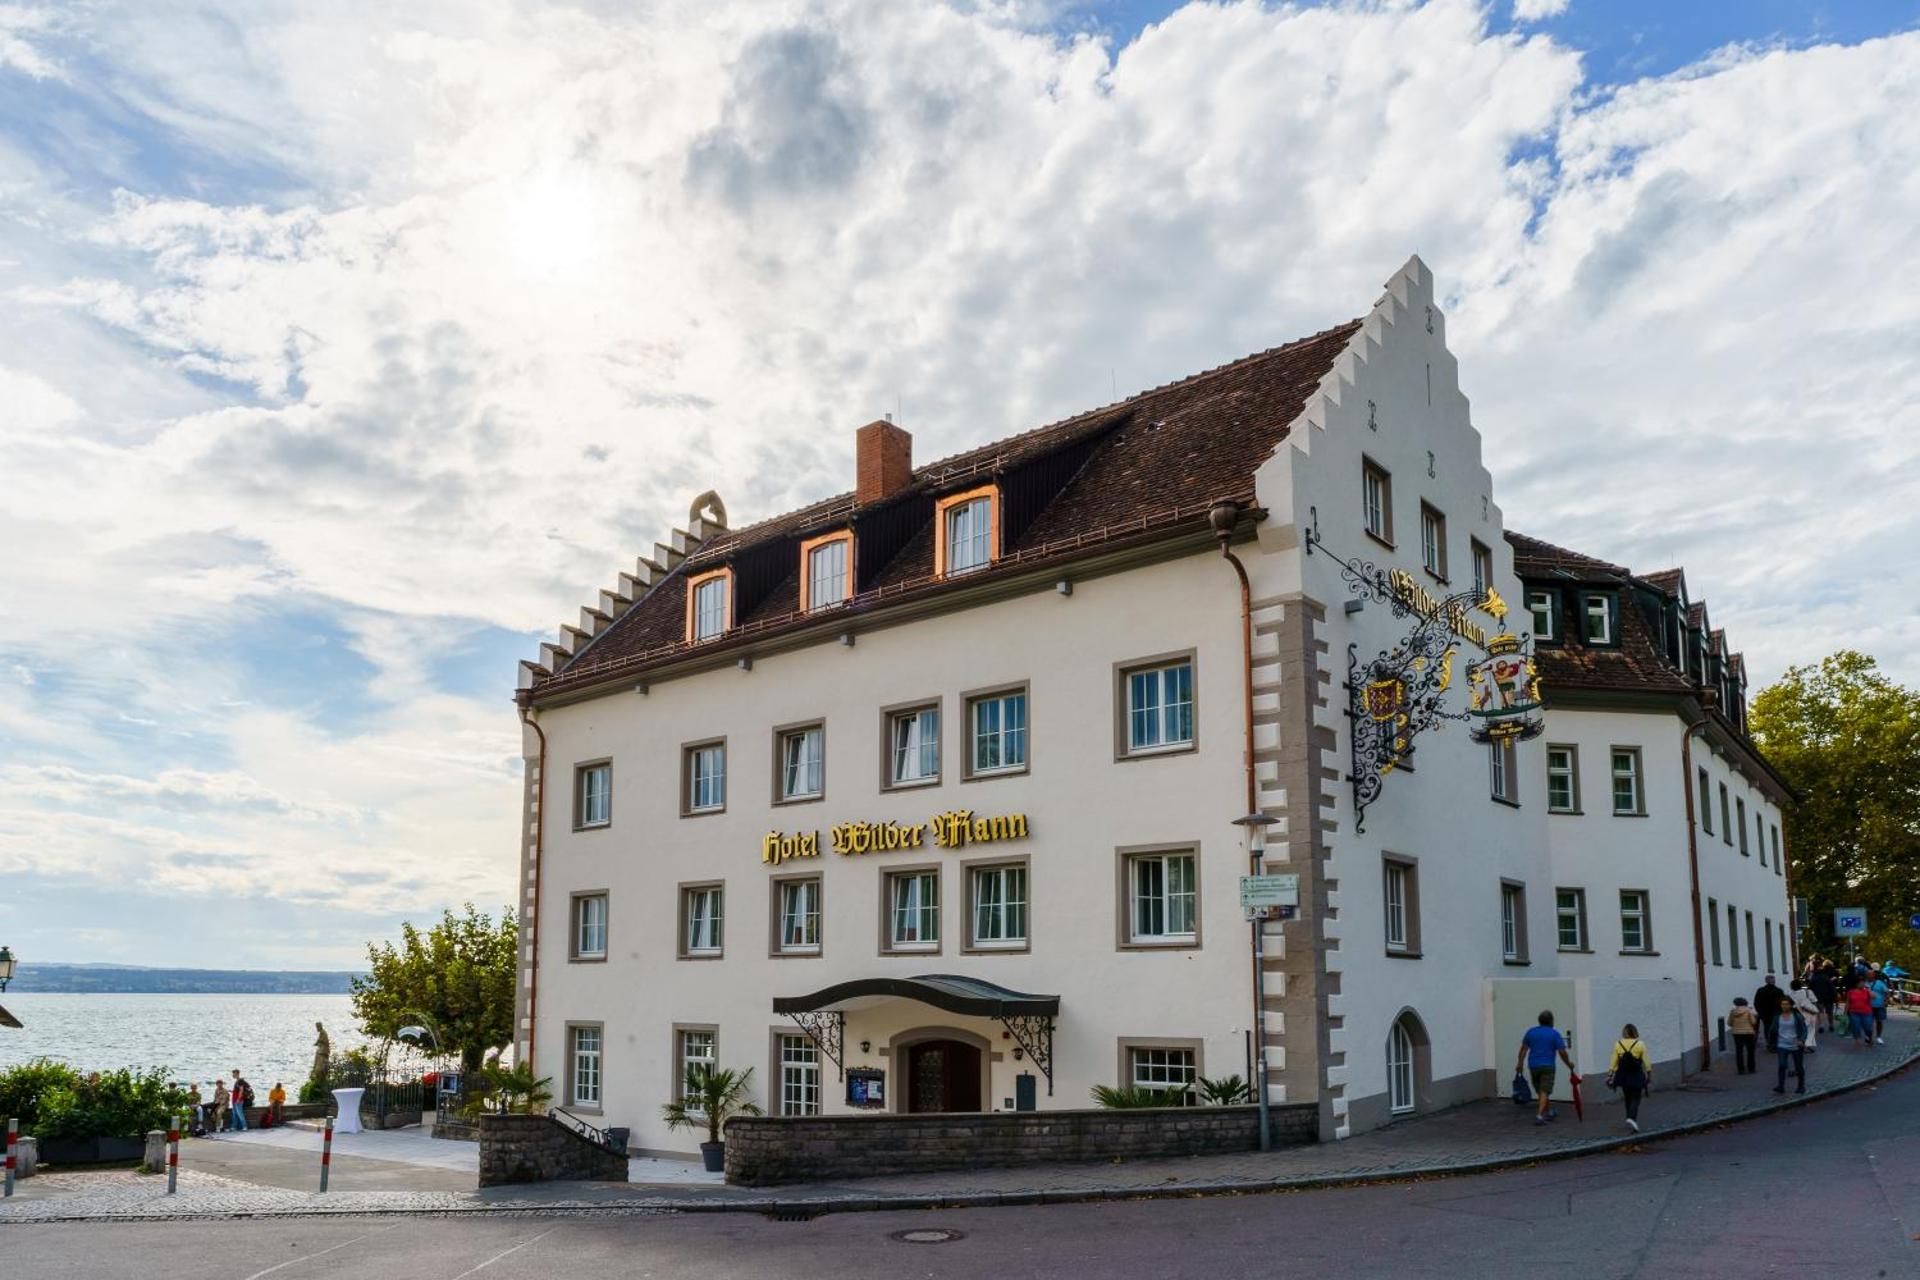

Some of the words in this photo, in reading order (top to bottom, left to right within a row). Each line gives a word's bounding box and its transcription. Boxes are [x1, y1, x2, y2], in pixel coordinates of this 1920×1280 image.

[762, 830, 819, 864] Hotel
[831, 820, 927, 855] Wilder
[930, 808, 1029, 849] Mann
